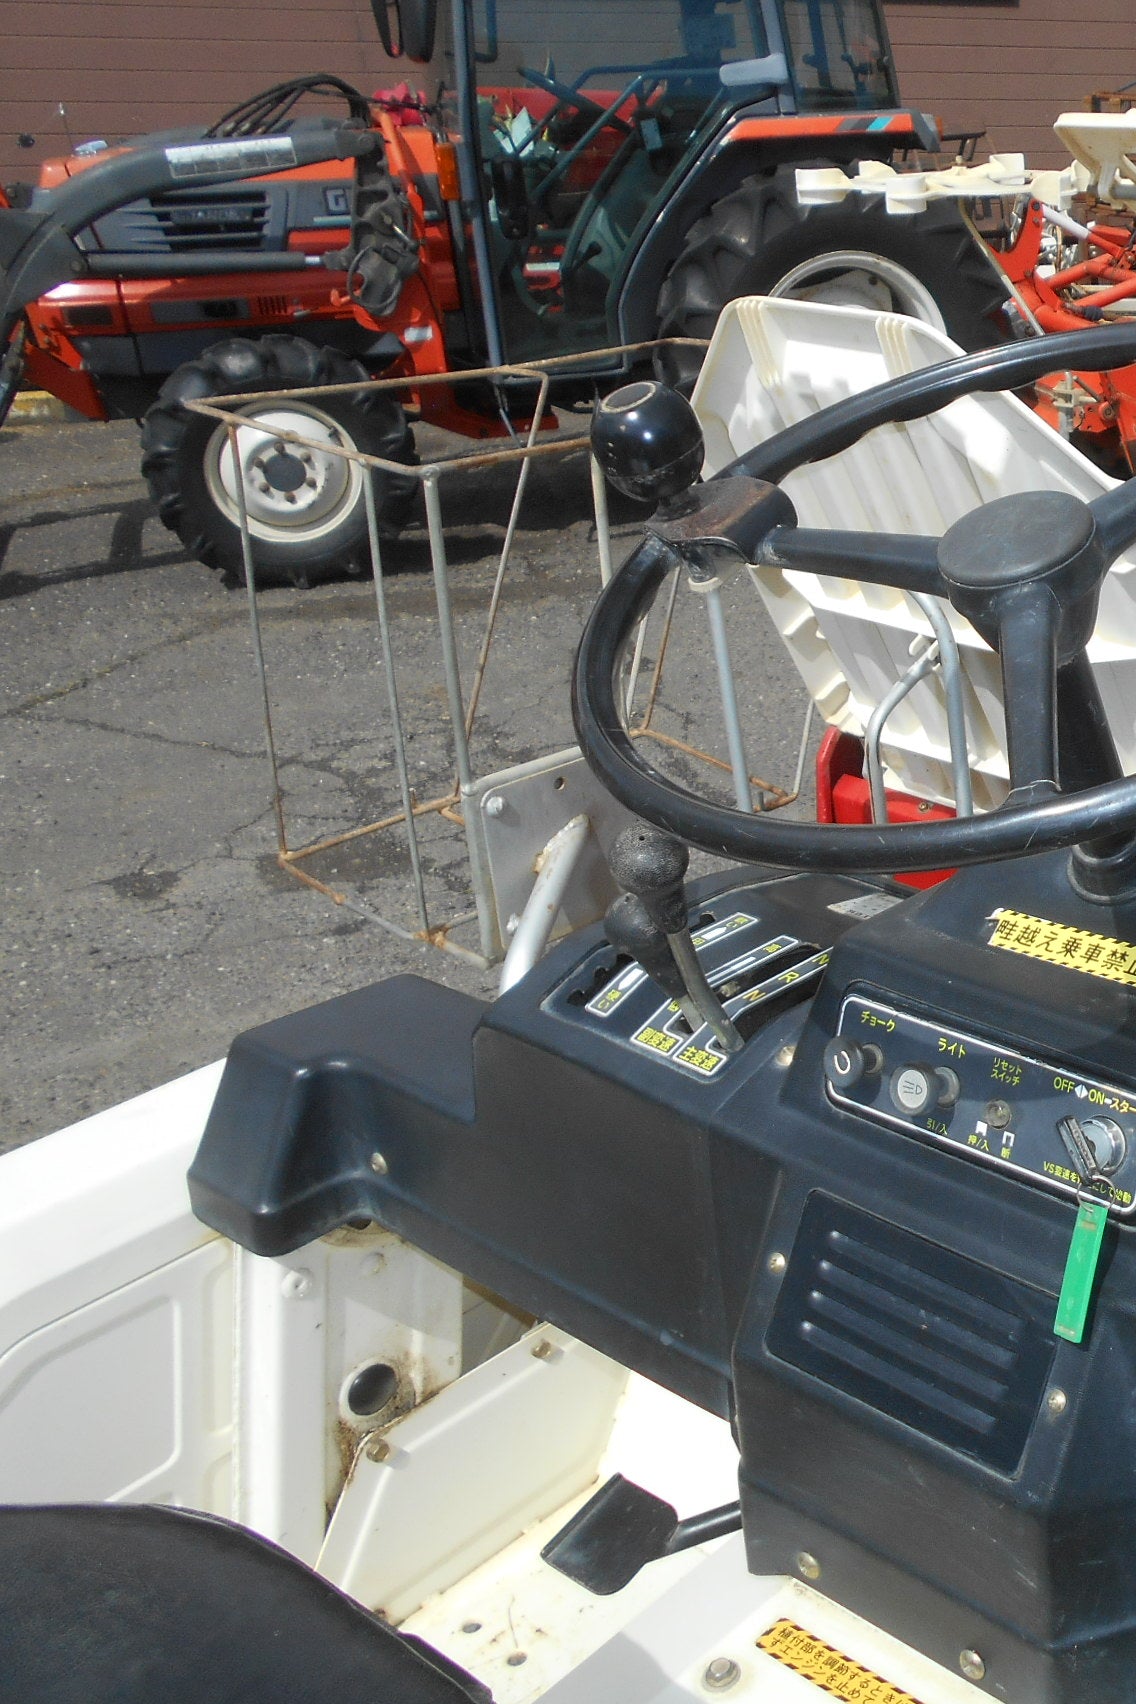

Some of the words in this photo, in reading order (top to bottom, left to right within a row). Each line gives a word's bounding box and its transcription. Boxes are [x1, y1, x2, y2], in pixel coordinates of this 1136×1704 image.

[777, 971, 800, 984] R
[742, 989, 766, 1002] N
[861, 1010, 896, 1032] チョーク
[636, 1026, 676, 1052] 副変速
[938, 1037, 966, 1059] ライト
[678, 1045, 720, 1071] 主変速
[993, 1056, 1022, 1075] リセット
[990, 1068, 1021, 1087] スイッチ
[1053, 1076, 1076, 1093] OFF
[1088, 1088, 1105, 1106] ON
[777, 1626, 908, 1704] 植付部を調節するとき
